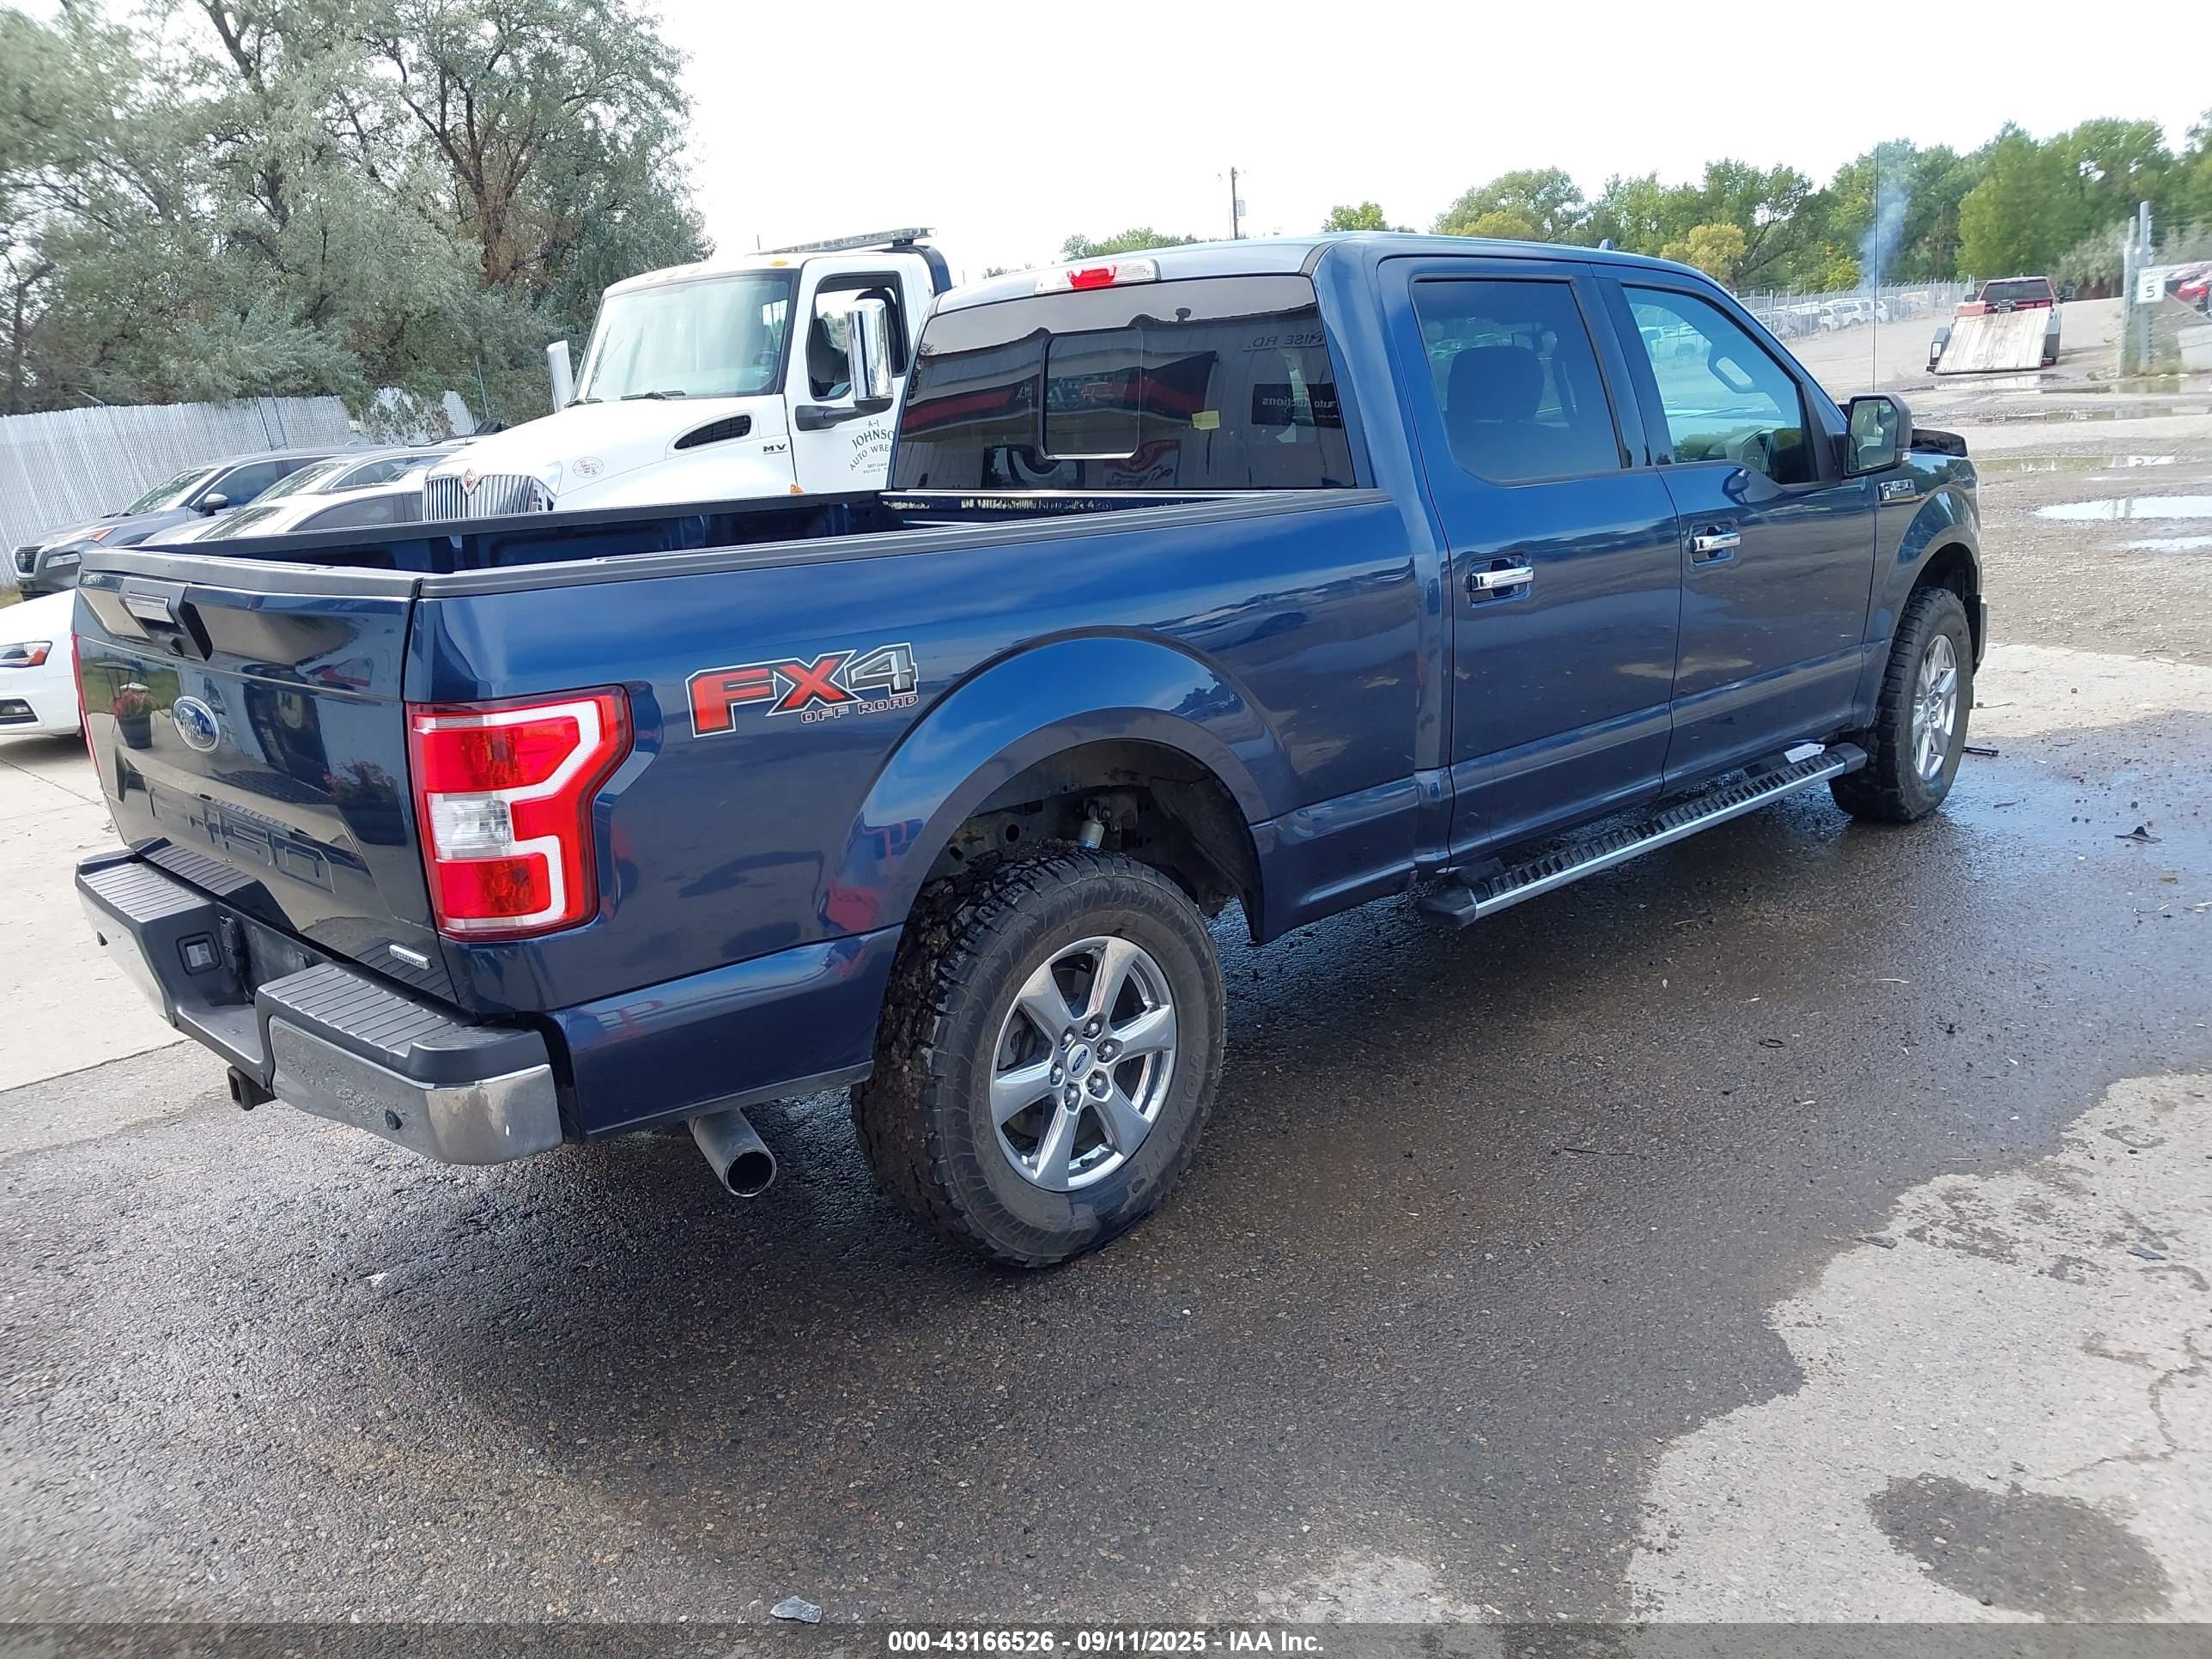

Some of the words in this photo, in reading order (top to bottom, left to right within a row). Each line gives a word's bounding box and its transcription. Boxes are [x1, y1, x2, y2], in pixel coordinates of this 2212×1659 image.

[2146, 285, 2155, 298] 5
[763, 443, 787, 453] MV
[850, 449, 868, 471] AUTO
[685, 642, 920, 738] FX4
[800, 705, 850, 724] OFF
[858, 694, 920, 714] ROAD
[179, 707, 205, 740] Ford
